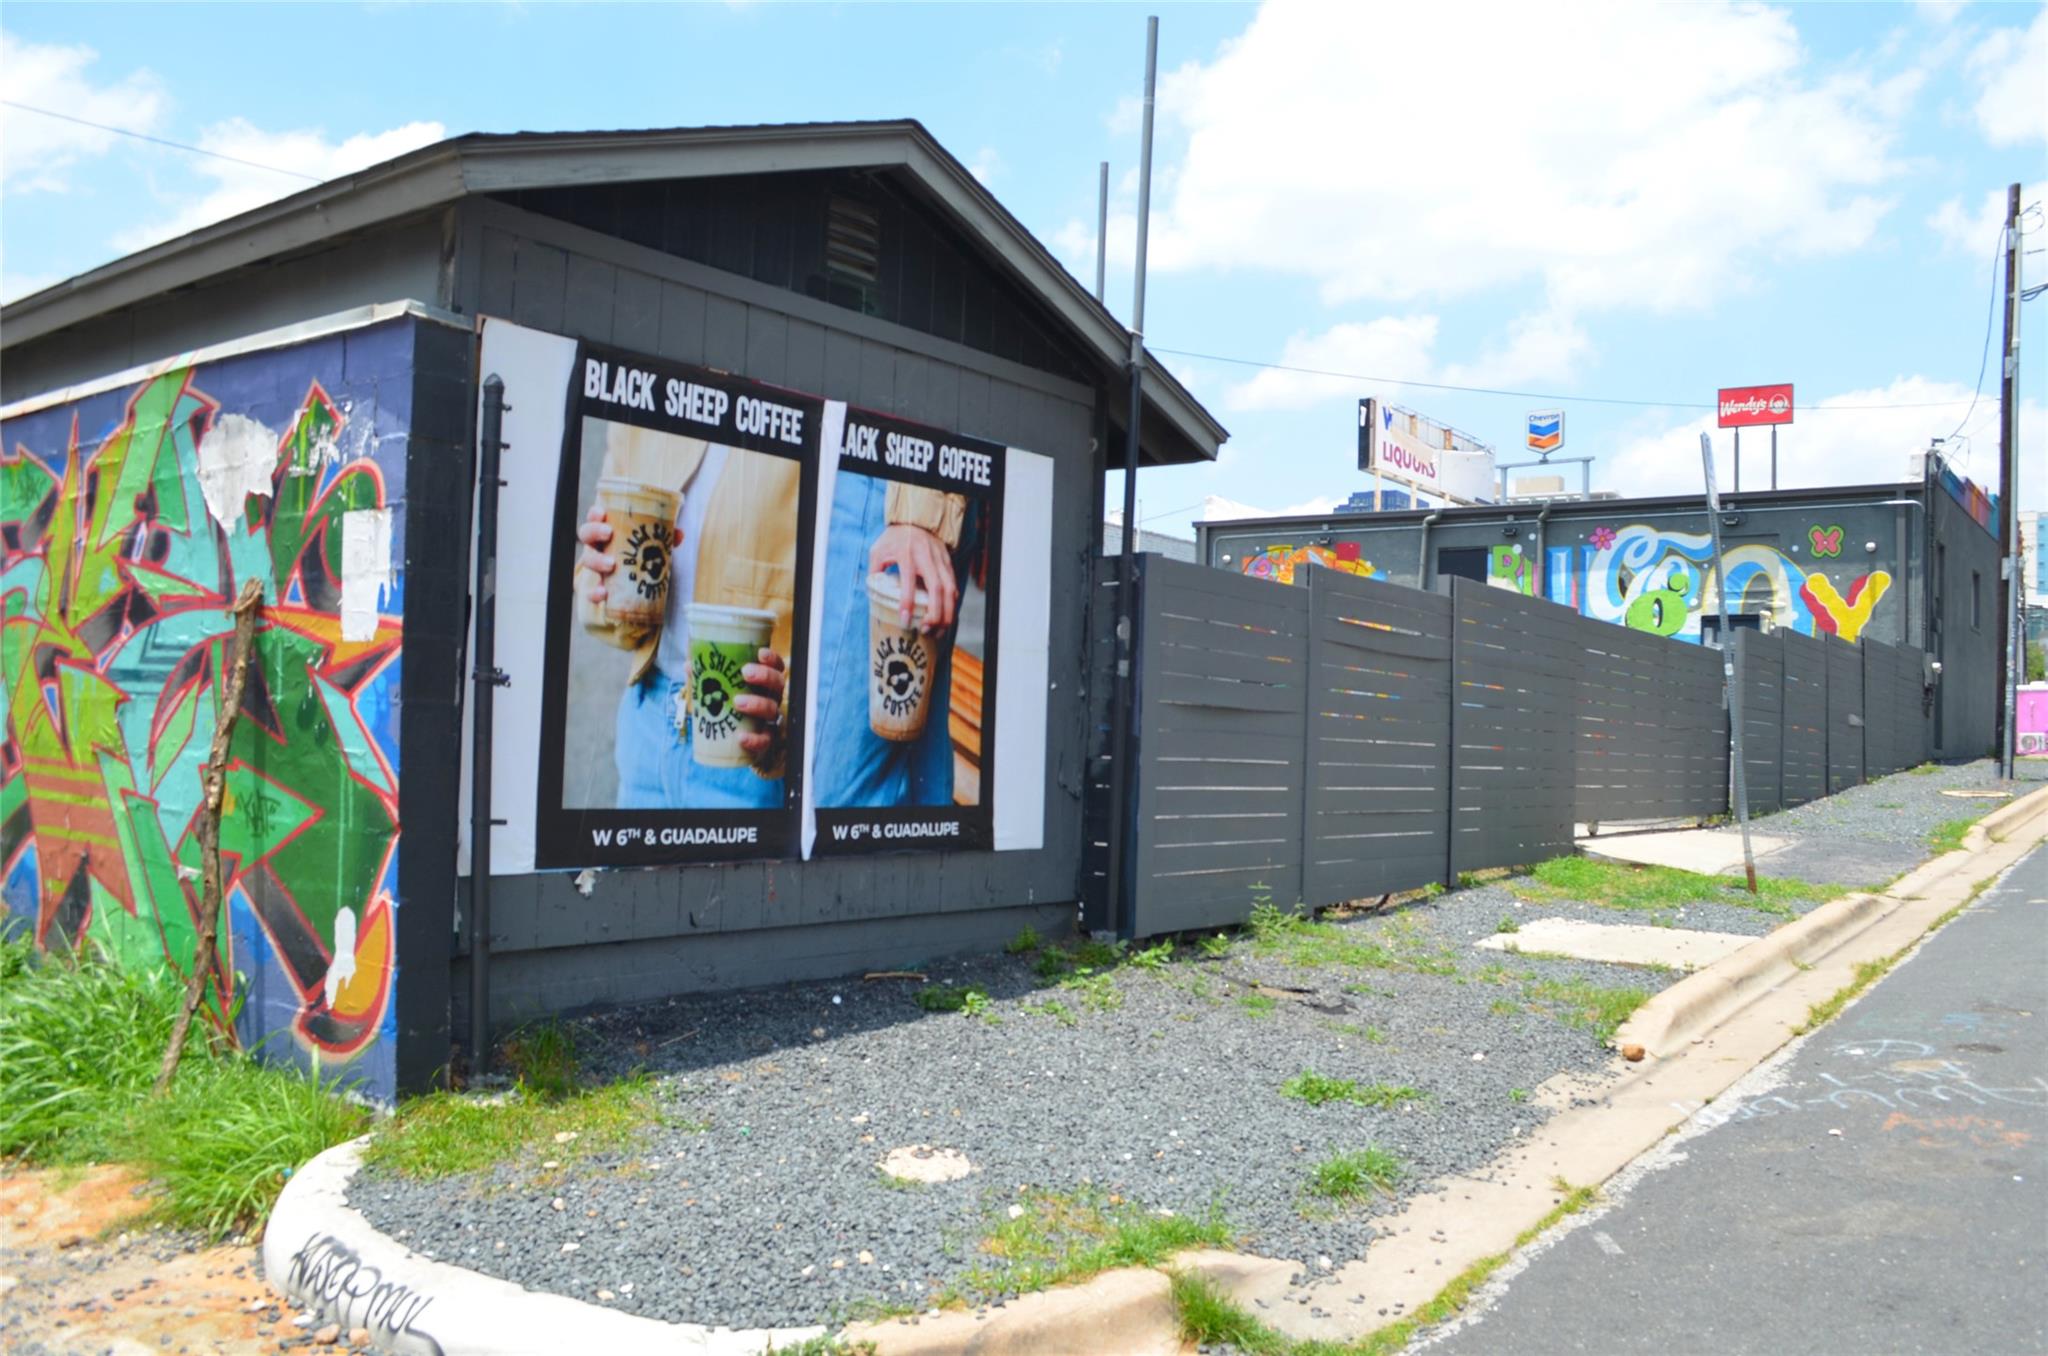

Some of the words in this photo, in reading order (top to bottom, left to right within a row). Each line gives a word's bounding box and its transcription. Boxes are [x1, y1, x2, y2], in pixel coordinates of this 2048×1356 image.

[584, 358, 657, 412] BLACK
[665, 378, 729, 426] SHEEP
[735, 395, 804, 445] COFFEE
[1720, 396, 1767, 418] Wendy's
[840, 423, 879, 462] ACK
[885, 432, 934, 472] SHEEP
[938, 445, 992, 486] COFFEE
[592, 829, 612, 846] W
[644, 829, 656, 845] &
[660, 827, 757, 844] GUADALUPE
[832, 824, 848, 840] W
[872, 823, 882, 839] &
[884, 821, 959, 838] GUADALUPE
